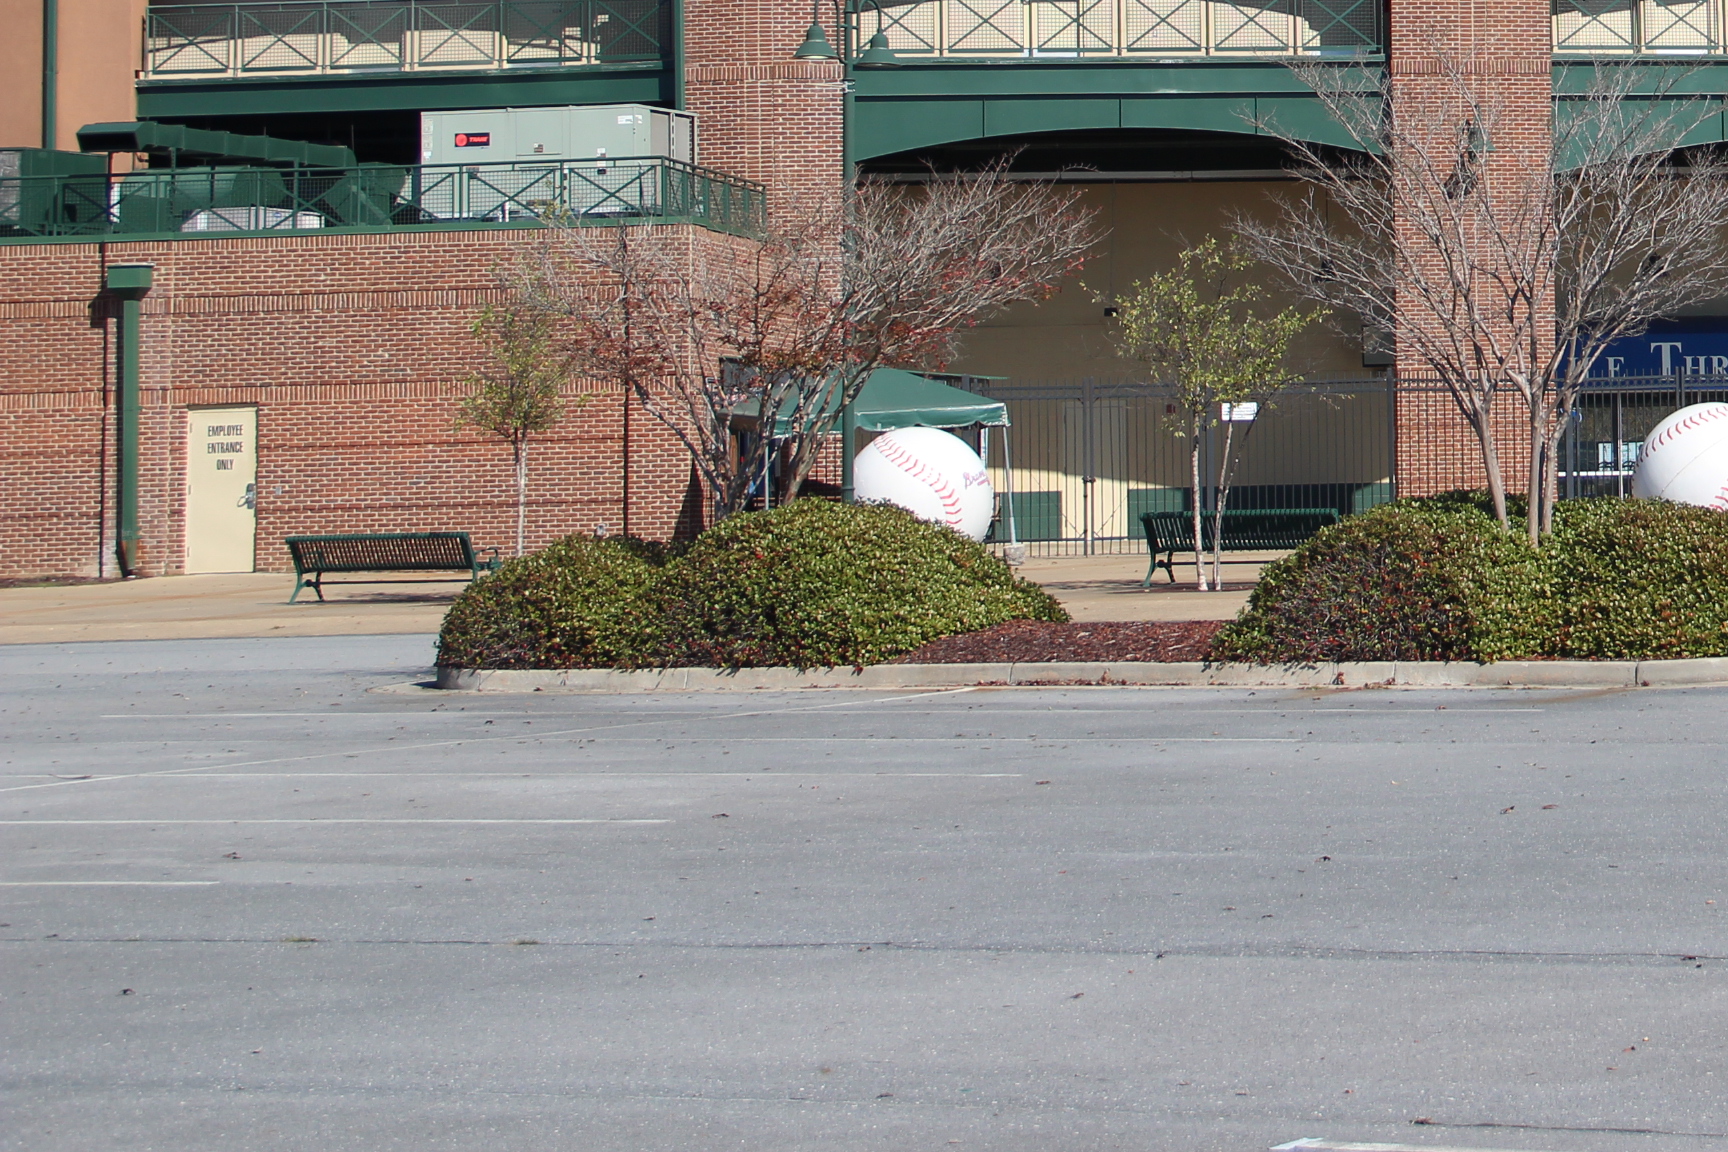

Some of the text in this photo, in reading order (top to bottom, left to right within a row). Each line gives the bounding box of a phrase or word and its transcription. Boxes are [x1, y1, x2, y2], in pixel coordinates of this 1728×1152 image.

[207, 424, 244, 437] EMPLOYEE
[207, 441, 244, 454] ENTRANCE
[216, 459, 234, 470] ONLY
